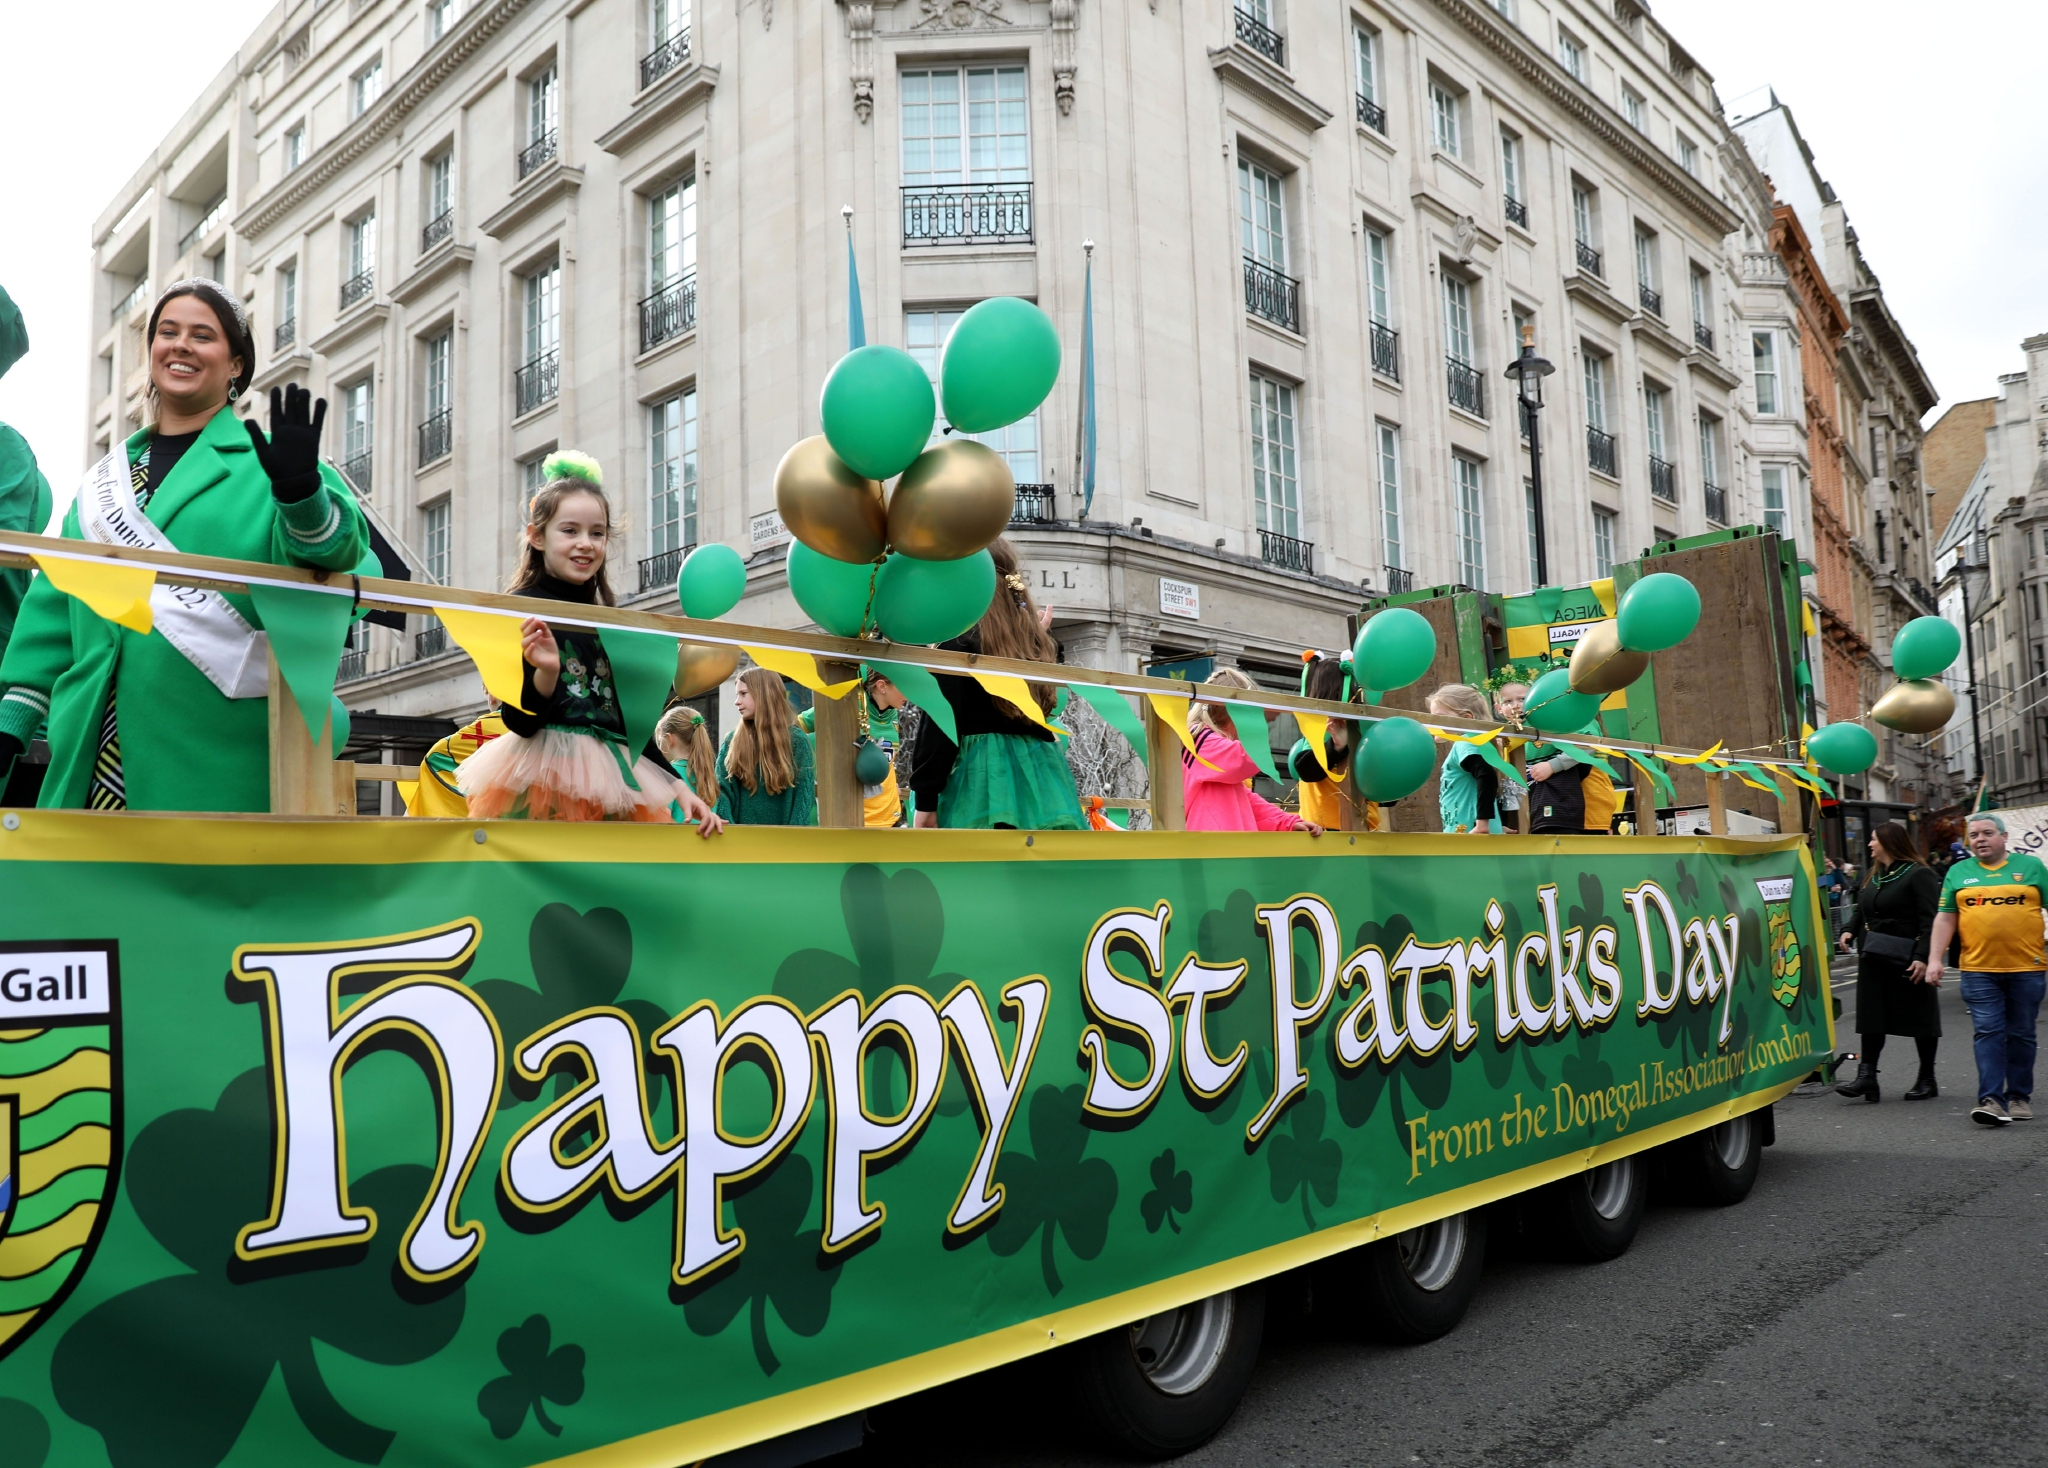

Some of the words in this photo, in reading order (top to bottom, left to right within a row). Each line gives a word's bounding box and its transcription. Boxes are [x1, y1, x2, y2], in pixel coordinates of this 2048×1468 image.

[753, 517, 773, 531] SPRING
[753, 526, 778, 541] GARDENS
[1163, 582, 1192, 596] COCKSPUR
[1164, 593, 1184, 605] STREET
[1185, 597, 1197, 607] SW1
[1965, 893, 2026, 907] circet
[232, 914, 1050, 1285] Happy
[1081, 898, 1248, 1117] St
[1248, 883, 1622, 1142] Patricks
[1622, 880, 1741, 1047] Day
[1405, 1111, 1494, 1185] From
[1499, 1092, 1549, 1146] the
[1552, 1063, 1649, 1133] Donegal
[1650, 1045, 1746, 1103] Association
[1748, 1024, 1812, 1074] London
